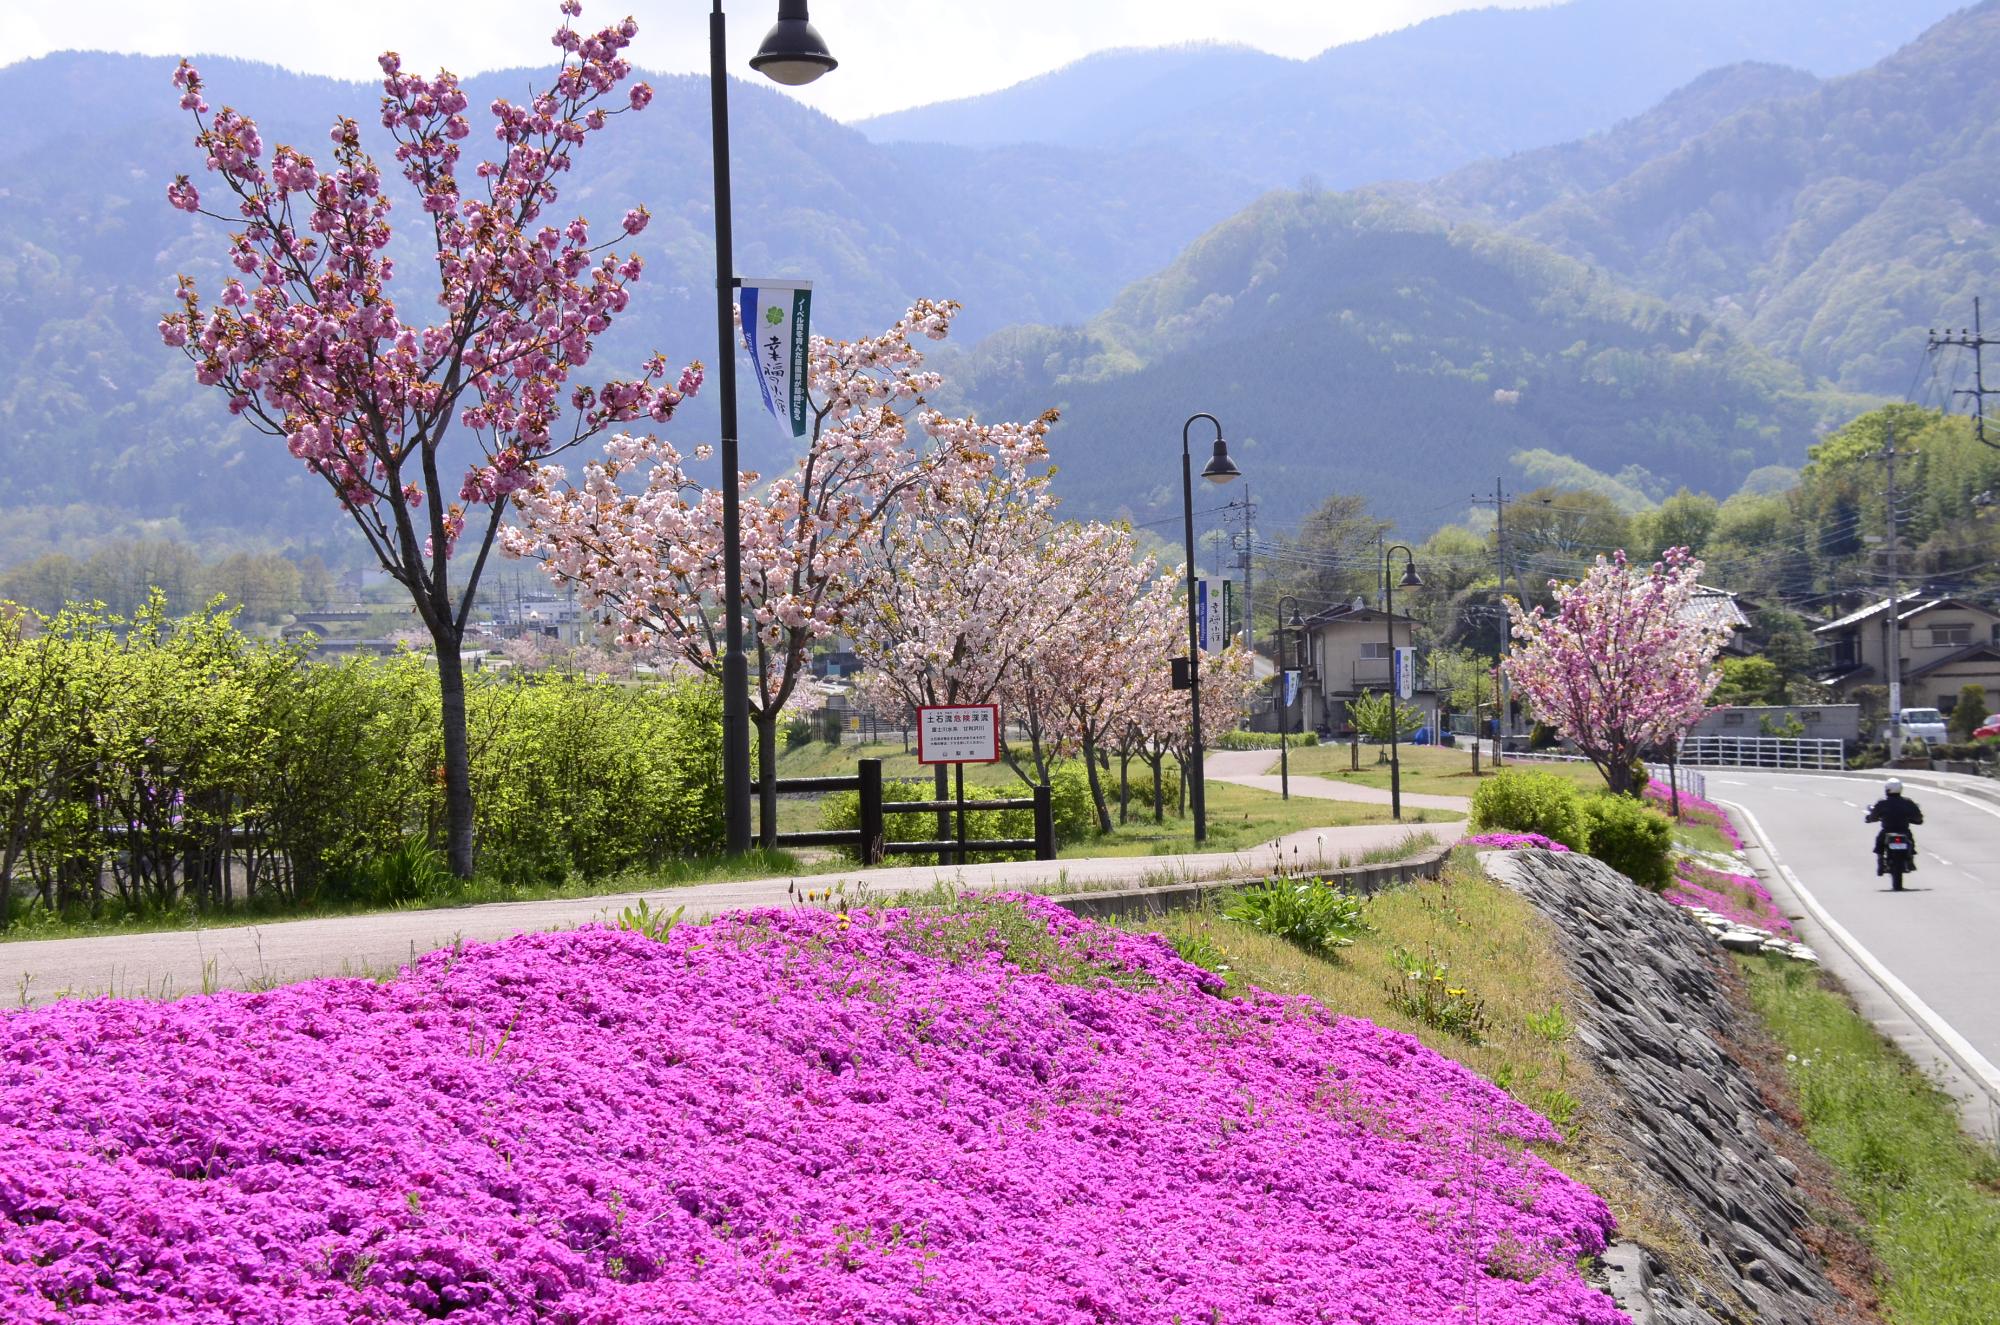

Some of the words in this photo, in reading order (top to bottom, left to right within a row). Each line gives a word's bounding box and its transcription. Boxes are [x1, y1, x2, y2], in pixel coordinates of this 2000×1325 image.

[927, 714, 989, 723] 土石流危険渓流
